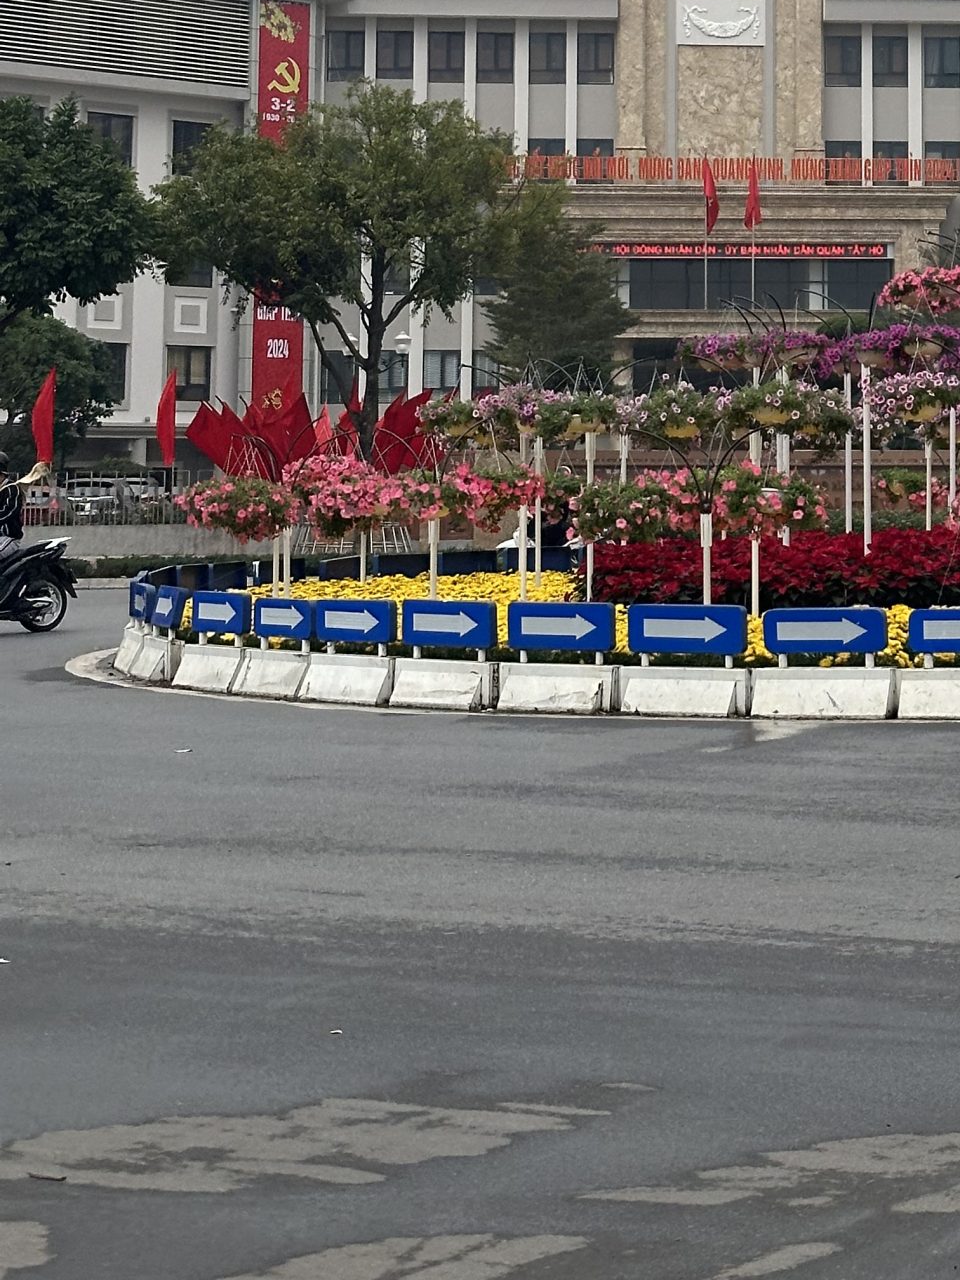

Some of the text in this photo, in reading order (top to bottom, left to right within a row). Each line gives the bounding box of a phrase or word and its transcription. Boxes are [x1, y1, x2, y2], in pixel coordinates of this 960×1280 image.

[271, 97, 296, 111] 3-2
[740, 245, 761, 255] BAN
[267, 339, 289, 358] 2024
